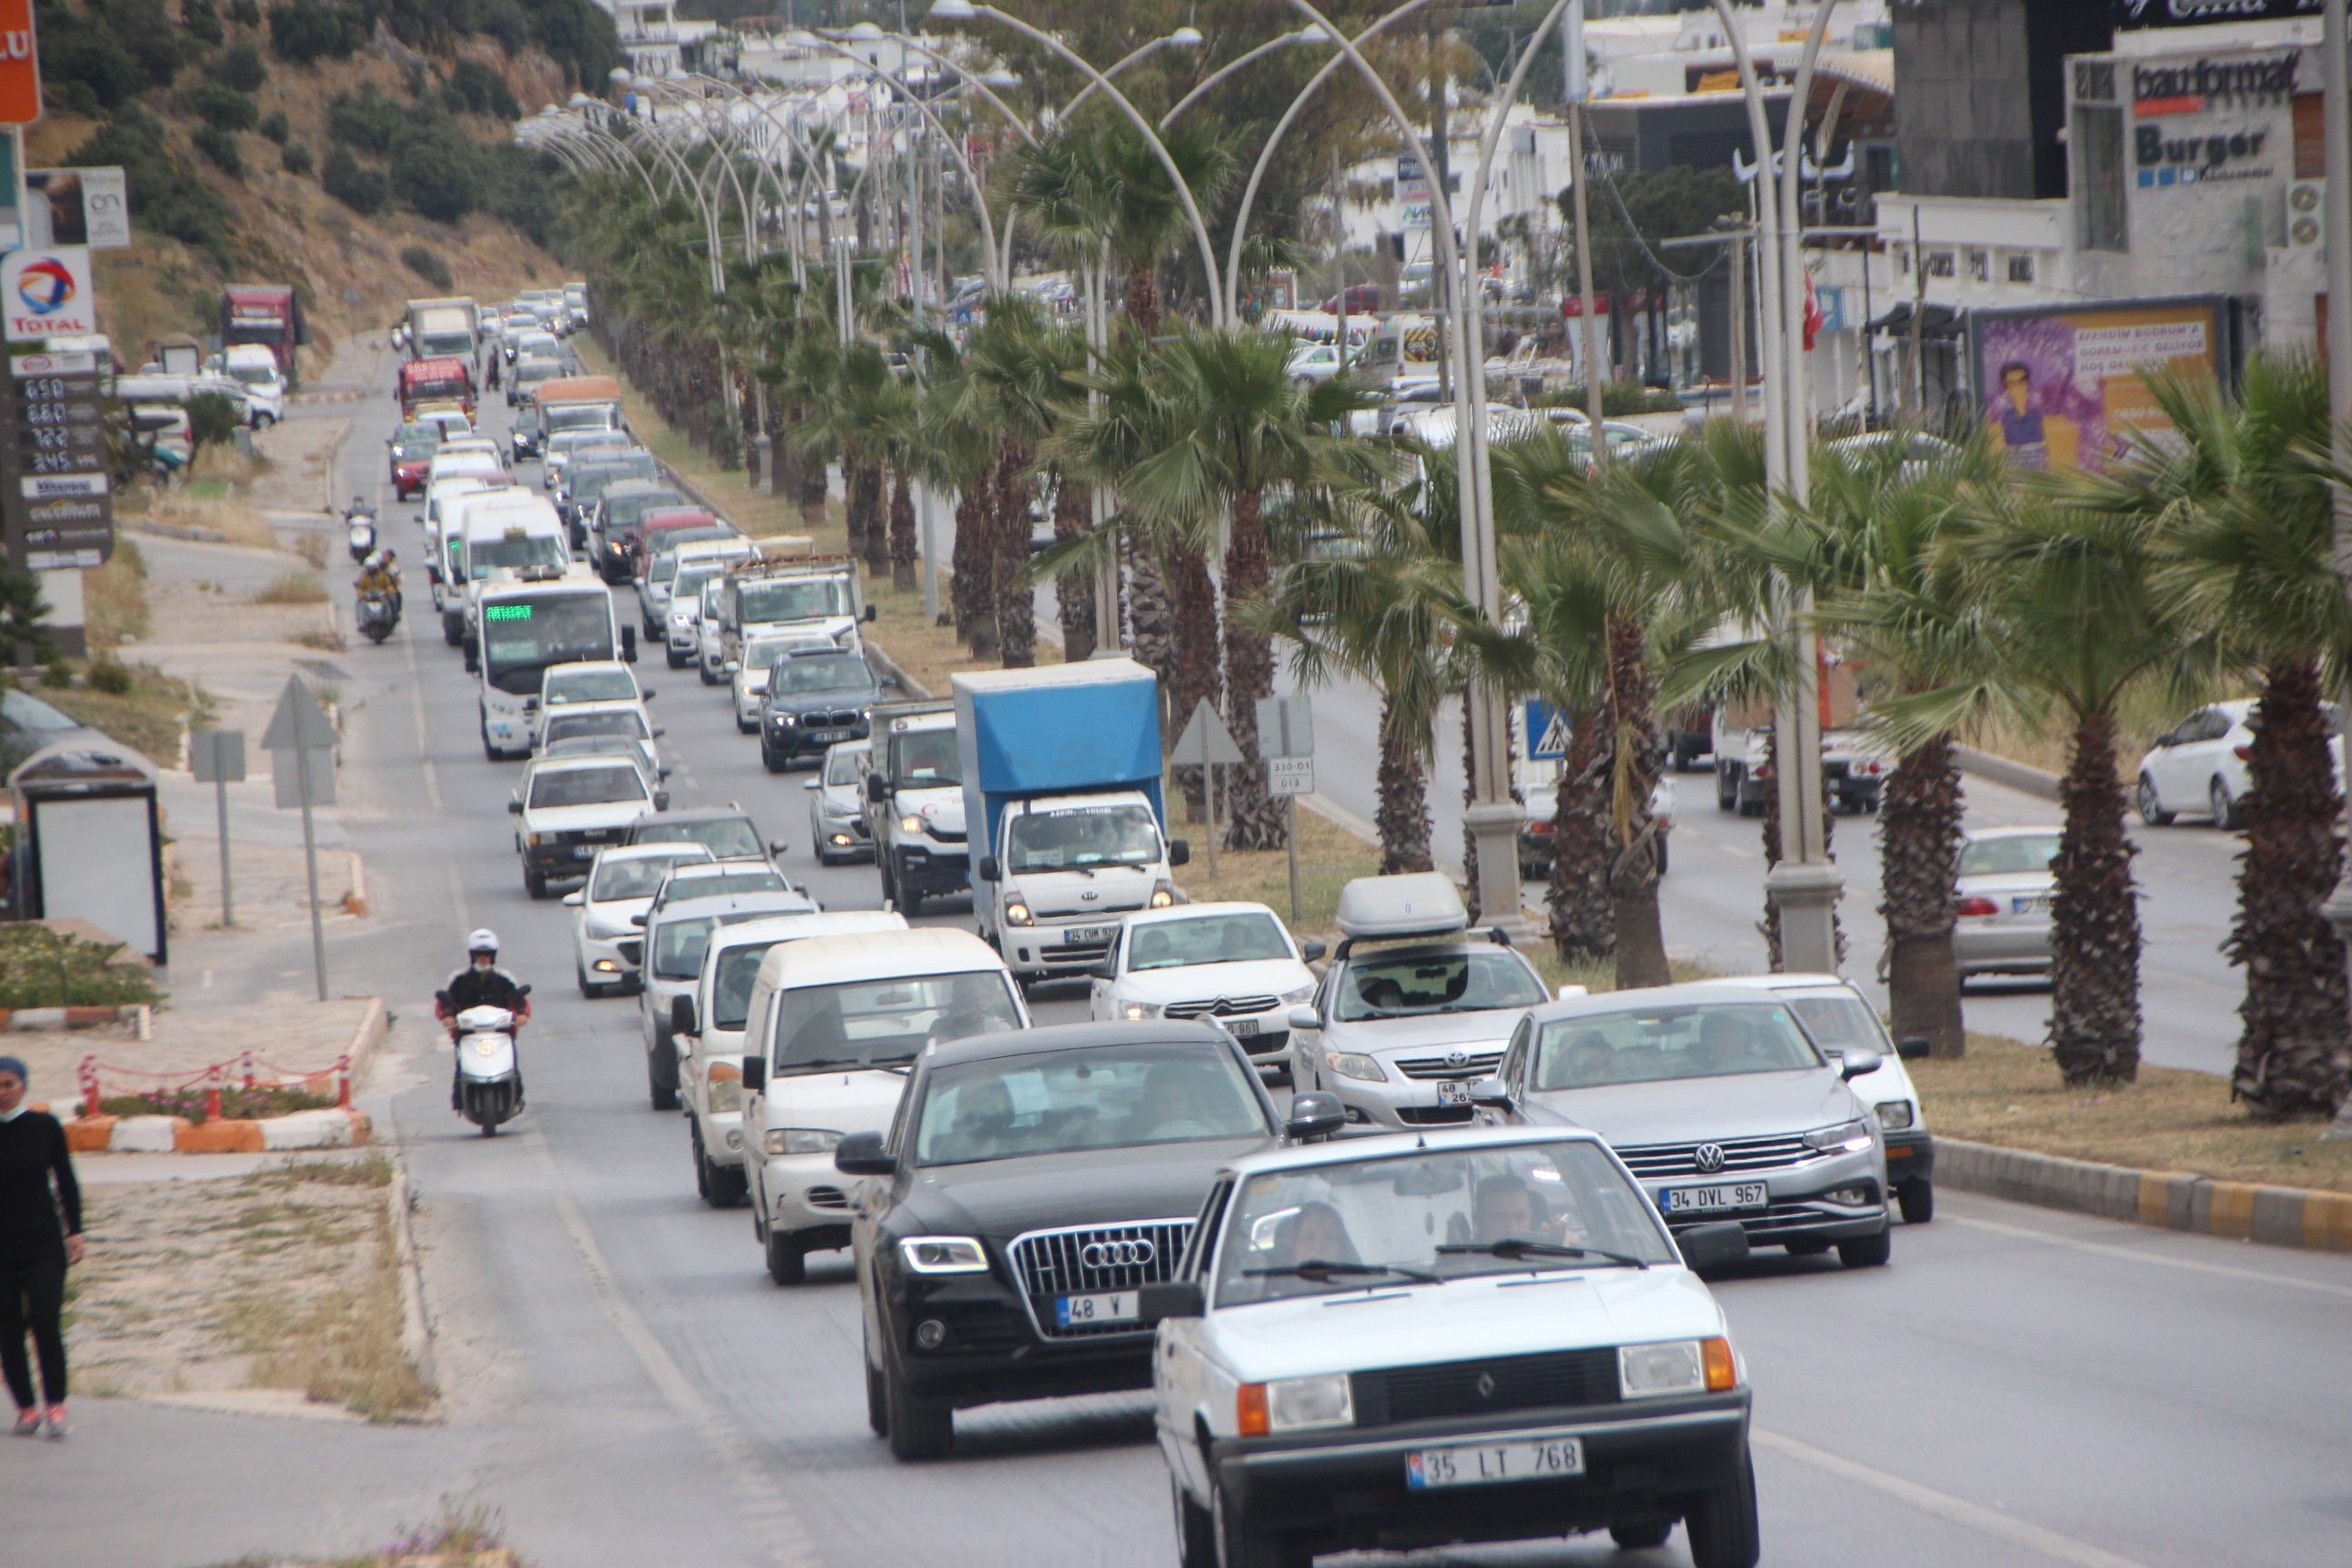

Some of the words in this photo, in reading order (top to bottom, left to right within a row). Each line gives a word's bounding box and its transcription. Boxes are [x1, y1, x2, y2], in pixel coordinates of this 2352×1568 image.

[2135, 123, 2267, 166] Burger
[13, 317, 87, 333] TOTAL
[1442, 1083, 1455, 1093] 48
[1671, 1191, 1690, 1208] 34
[1699, 1189, 1726, 1206] DVL
[1735, 1185, 1762, 1203] 967
[1072, 1298, 1094, 1318] 48
[1110, 1295, 1120, 1316] V
[1427, 1453, 1455, 1482] 35
[1479, 1448, 1506, 1476] LT
[1533, 1441, 1577, 1471] 768
